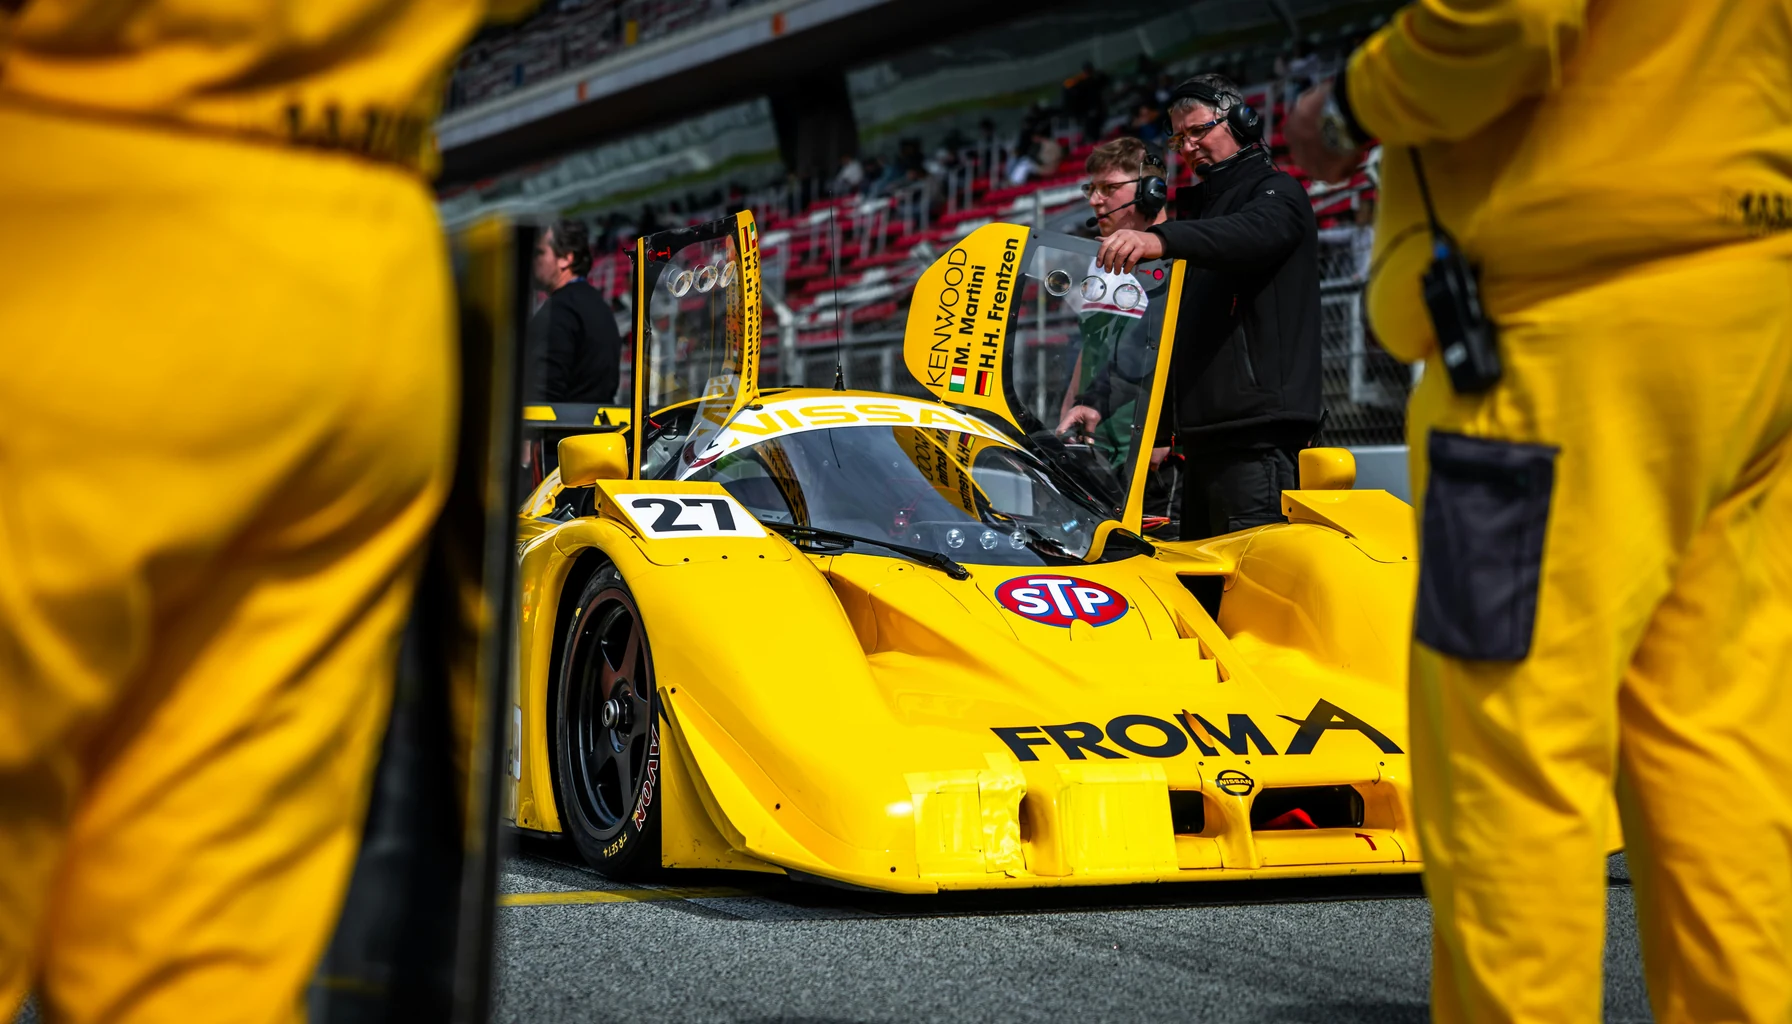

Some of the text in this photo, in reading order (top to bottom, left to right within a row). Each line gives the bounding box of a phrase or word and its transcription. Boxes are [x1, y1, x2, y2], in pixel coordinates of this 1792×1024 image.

[744, 255, 754, 393] H.H. Frentzen
[926, 248, 967, 387] KENWOOD
[953, 265, 986, 365] M. Martini
[978, 238, 1019, 369] H.H. Frentzen
[727, 404, 1024, 449] NISSAN
[631, 498, 737, 532] 27
[1010, 579, 1111, 616] STP
[990, 713, 1278, 761] FROM
[633, 723, 660, 832] AVON
[1219, 778, 1252, 786] NISSAN
